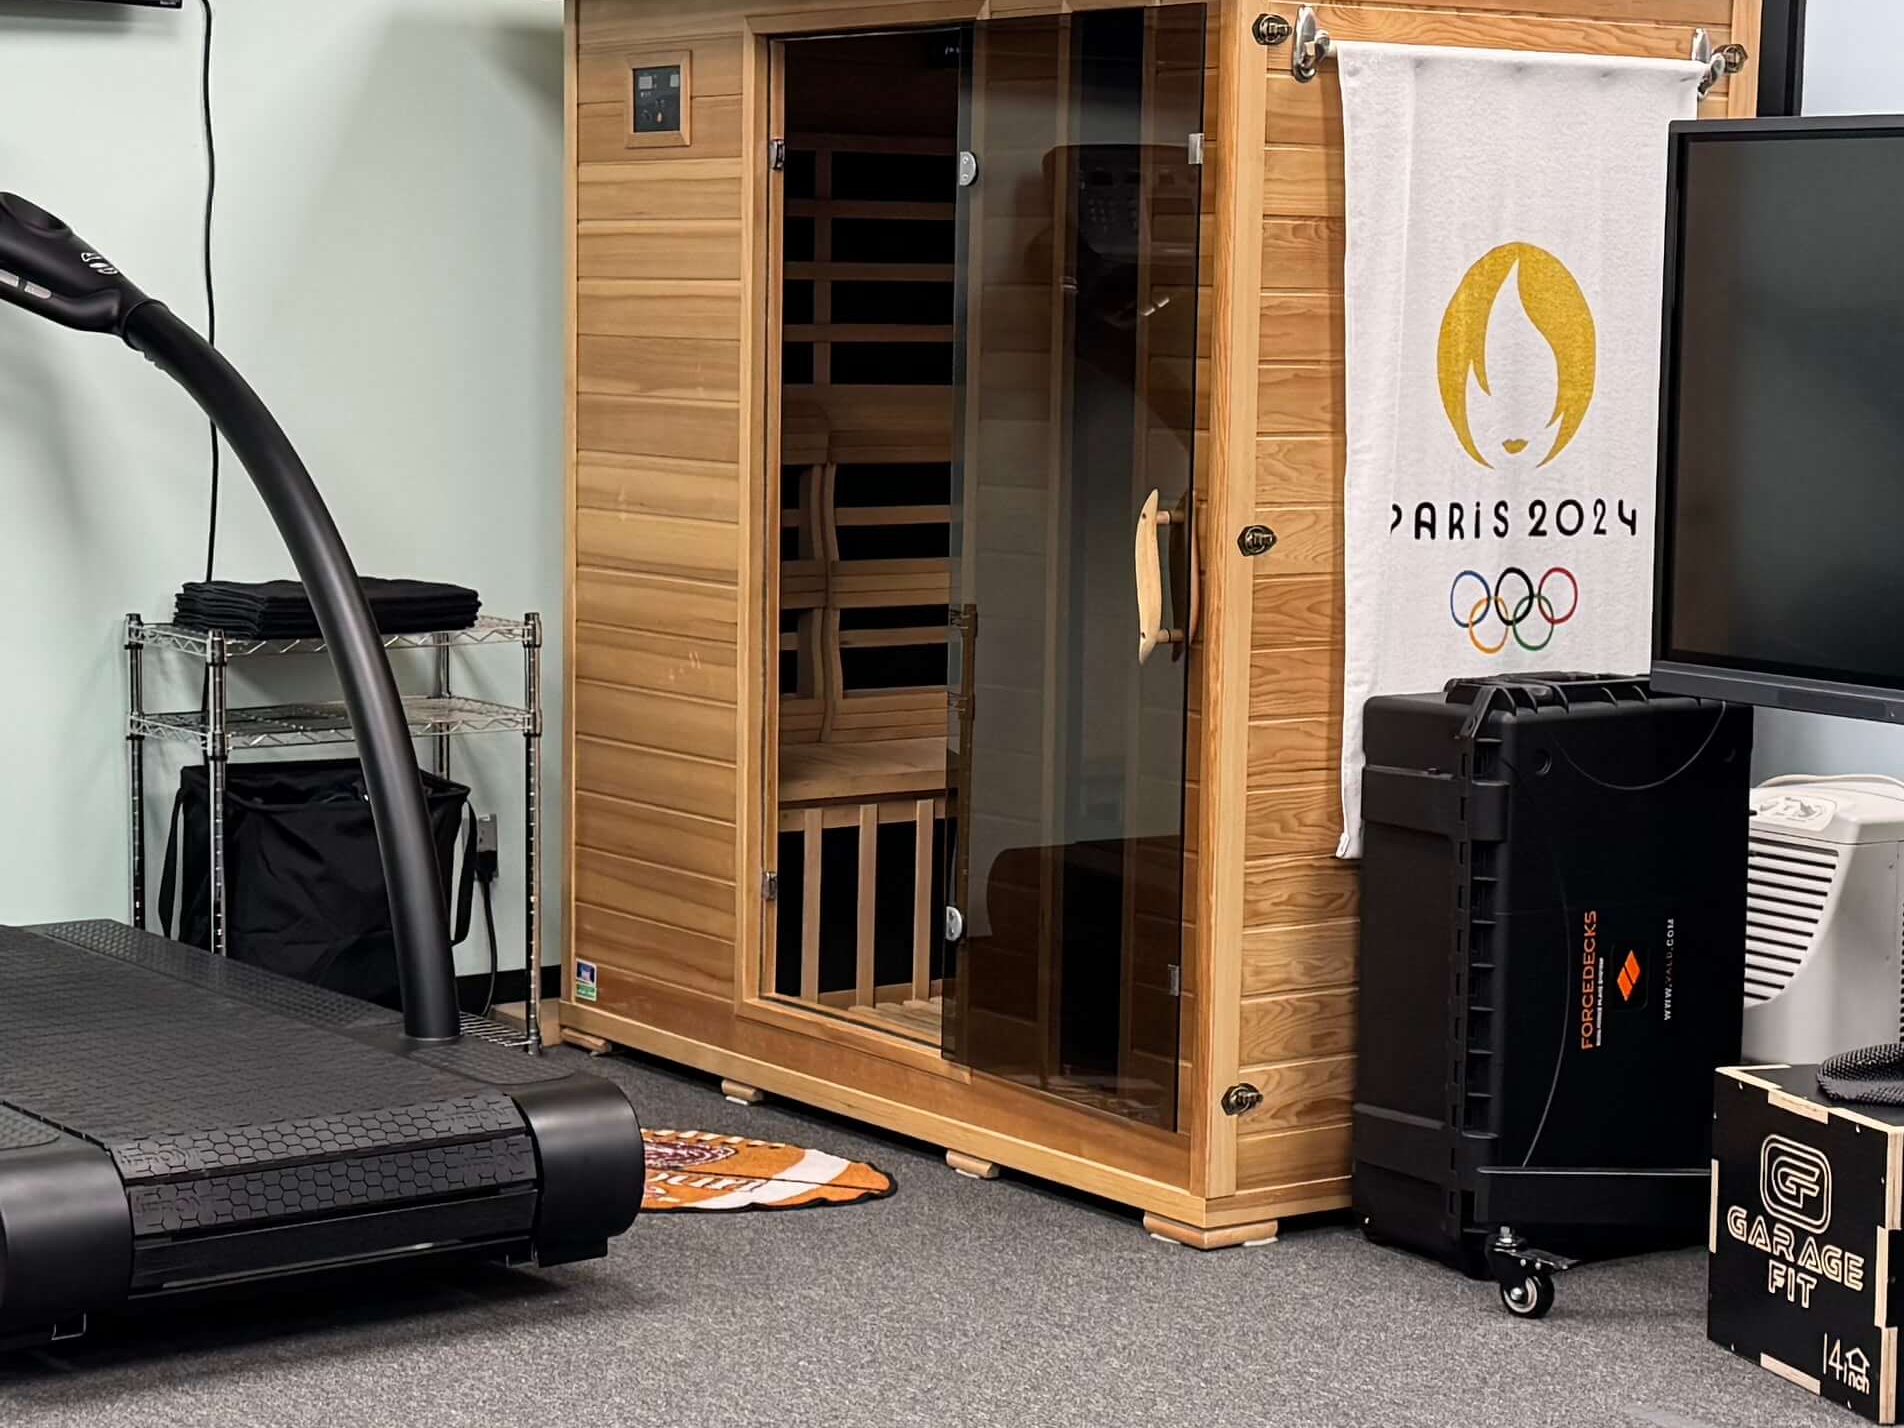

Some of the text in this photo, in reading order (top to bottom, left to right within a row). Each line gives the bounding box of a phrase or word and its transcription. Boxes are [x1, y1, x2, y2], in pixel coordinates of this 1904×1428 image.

[1528, 498, 1637, 536] 2024
[1581, 910, 1597, 1051] FORCEDECKS
[1727, 1205, 1864, 1291] GARAGE
[1768, 1259, 1817, 1309] FIT
